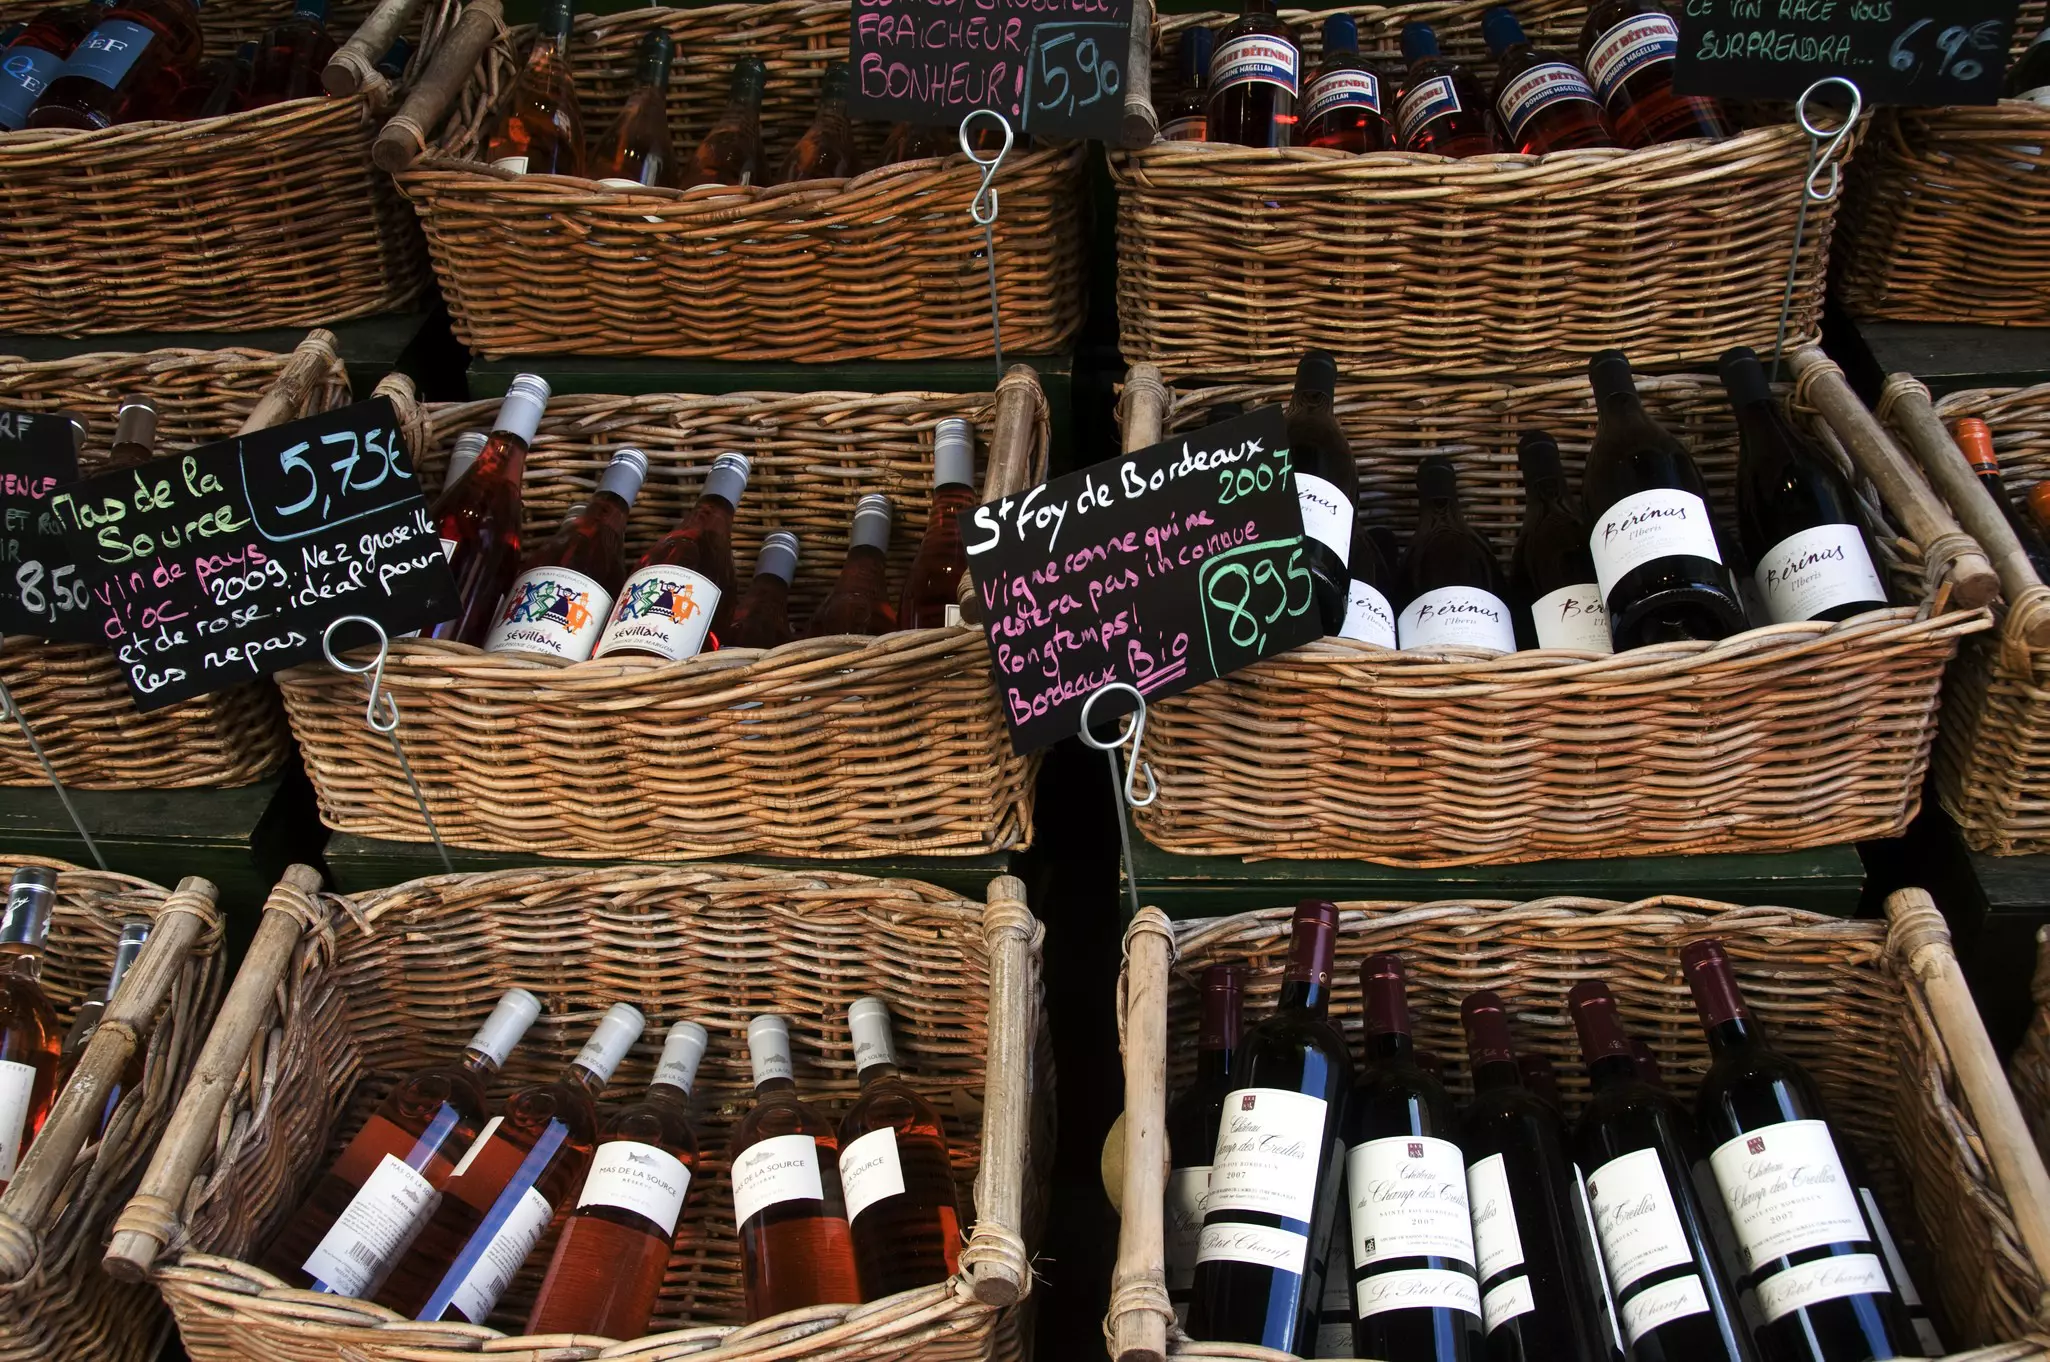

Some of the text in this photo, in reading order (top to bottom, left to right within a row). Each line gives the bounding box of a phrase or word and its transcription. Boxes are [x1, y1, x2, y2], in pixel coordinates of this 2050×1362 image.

[1037, 32, 1120, 118] 5,90
[1240, 64, 1274, 74] MAGELLAN
[1603, 42, 1662, 86] DOMAINE MAGELLAN
[1316, 92, 1350, 108] MAGELLAN
[1525, 87, 1555, 109] DOMAINE
[134, 469, 175, 513] de
[182, 455, 224, 498] la
[1076, 475, 1114, 514] de
[1120, 437, 1264, 500] Bordeaux
[1218, 448, 1292, 505] 2007
[97, 505, 252, 564] Source
[152, 556, 187, 589] de
[195, 543, 268, 597] pays
[16, 559, 90, 623] 8,50
[154, 624, 190, 652] de
[379, 551, 444, 597] pour
[1088, 567, 1140, 614] pas
[131, 664, 188, 694] les
[1008, 631, 1190, 726] Bordeaux Bio
[1237, 1137, 1255, 1152] des
[598, 1165, 678, 1199] MAS DE LA SOURCE
[743, 1173, 754, 1186] DE
[754, 1167, 766, 1179] LA
[766, 1160, 806, 1173] SOURCE
[852, 1156, 885, 1179] SOURCE
[1226, 1171, 1247, 1180] 2007
[1367, 1179, 1416, 1208] Champ
[1417, 1184, 1436, 1199] des
[1612, 1193, 1657, 1226] Treilles
[1769, 1211, 1794, 1225] 2007
[1232, 1232, 1292, 1261] Champ
[1818, 1266, 1877, 1290] Champ
